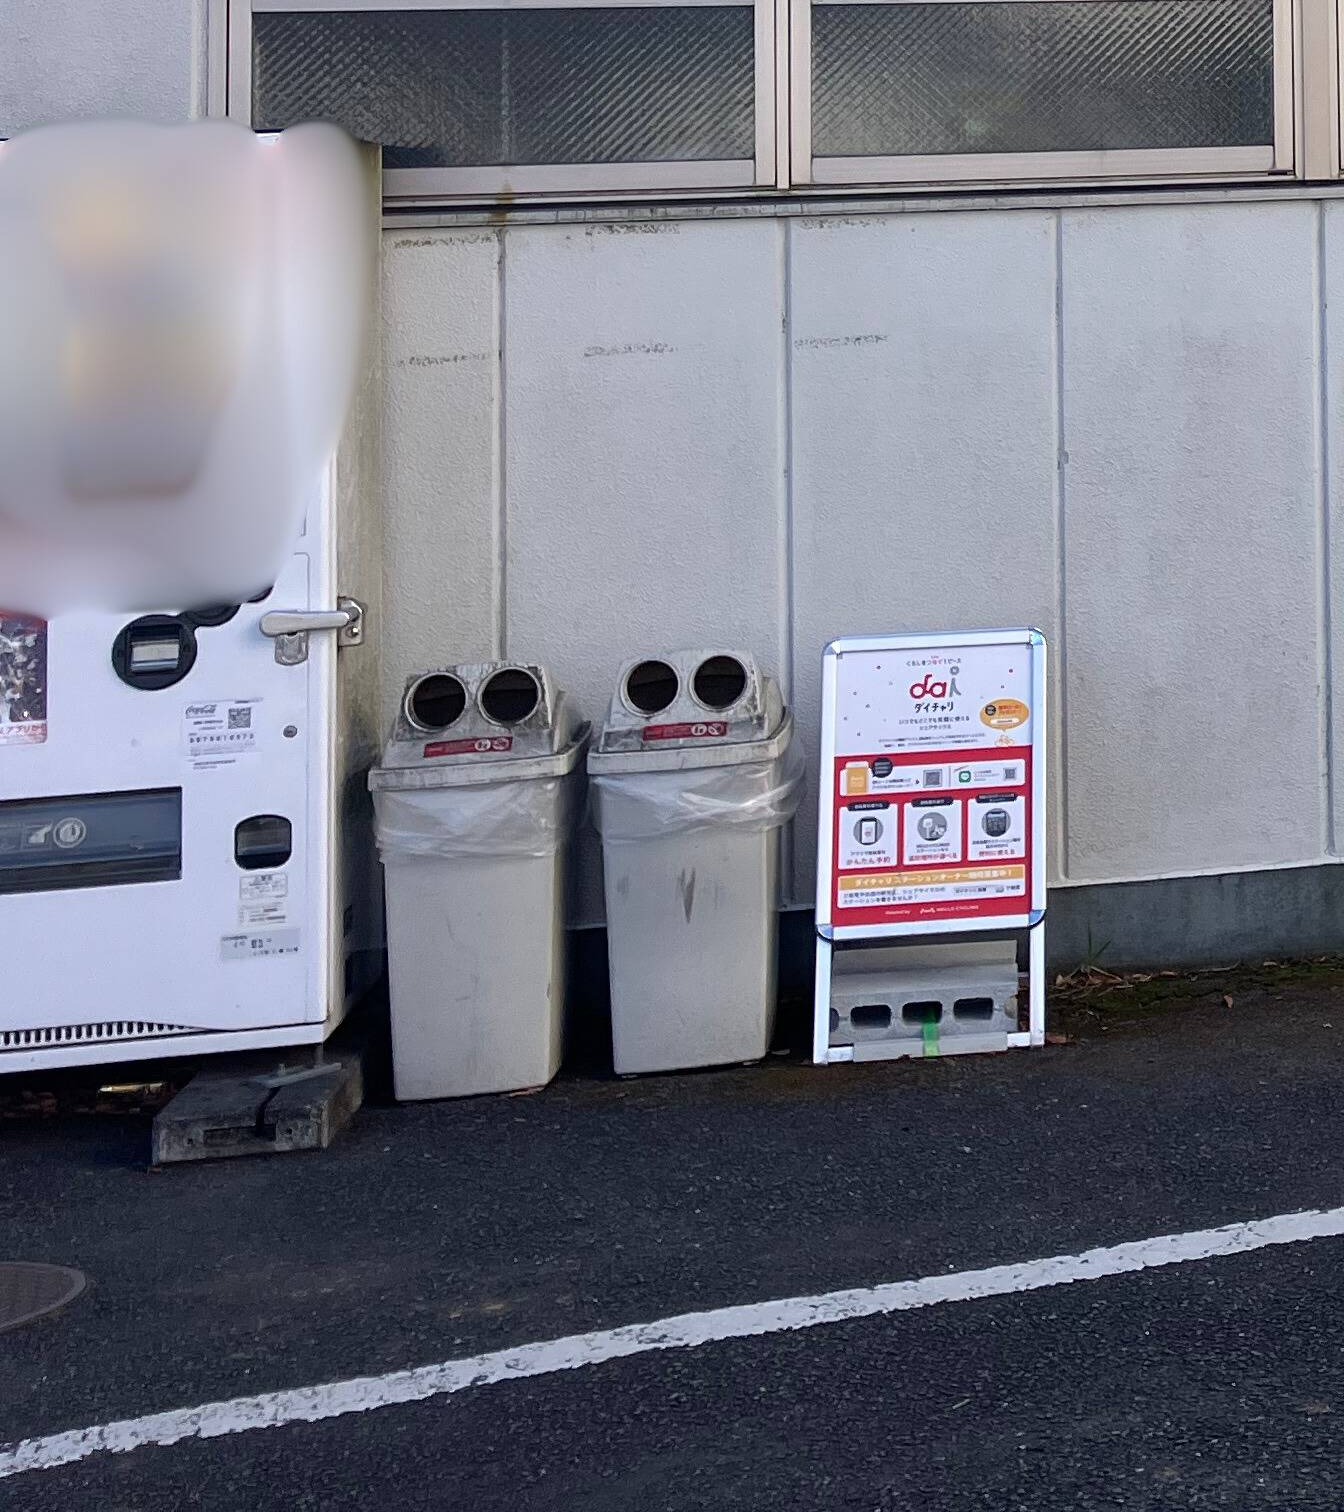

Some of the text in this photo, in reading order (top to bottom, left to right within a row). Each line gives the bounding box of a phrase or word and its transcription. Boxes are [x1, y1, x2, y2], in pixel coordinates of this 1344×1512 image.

[909, 666, 962, 699] dai
[914, 700, 954, 714] ダイチャリ
